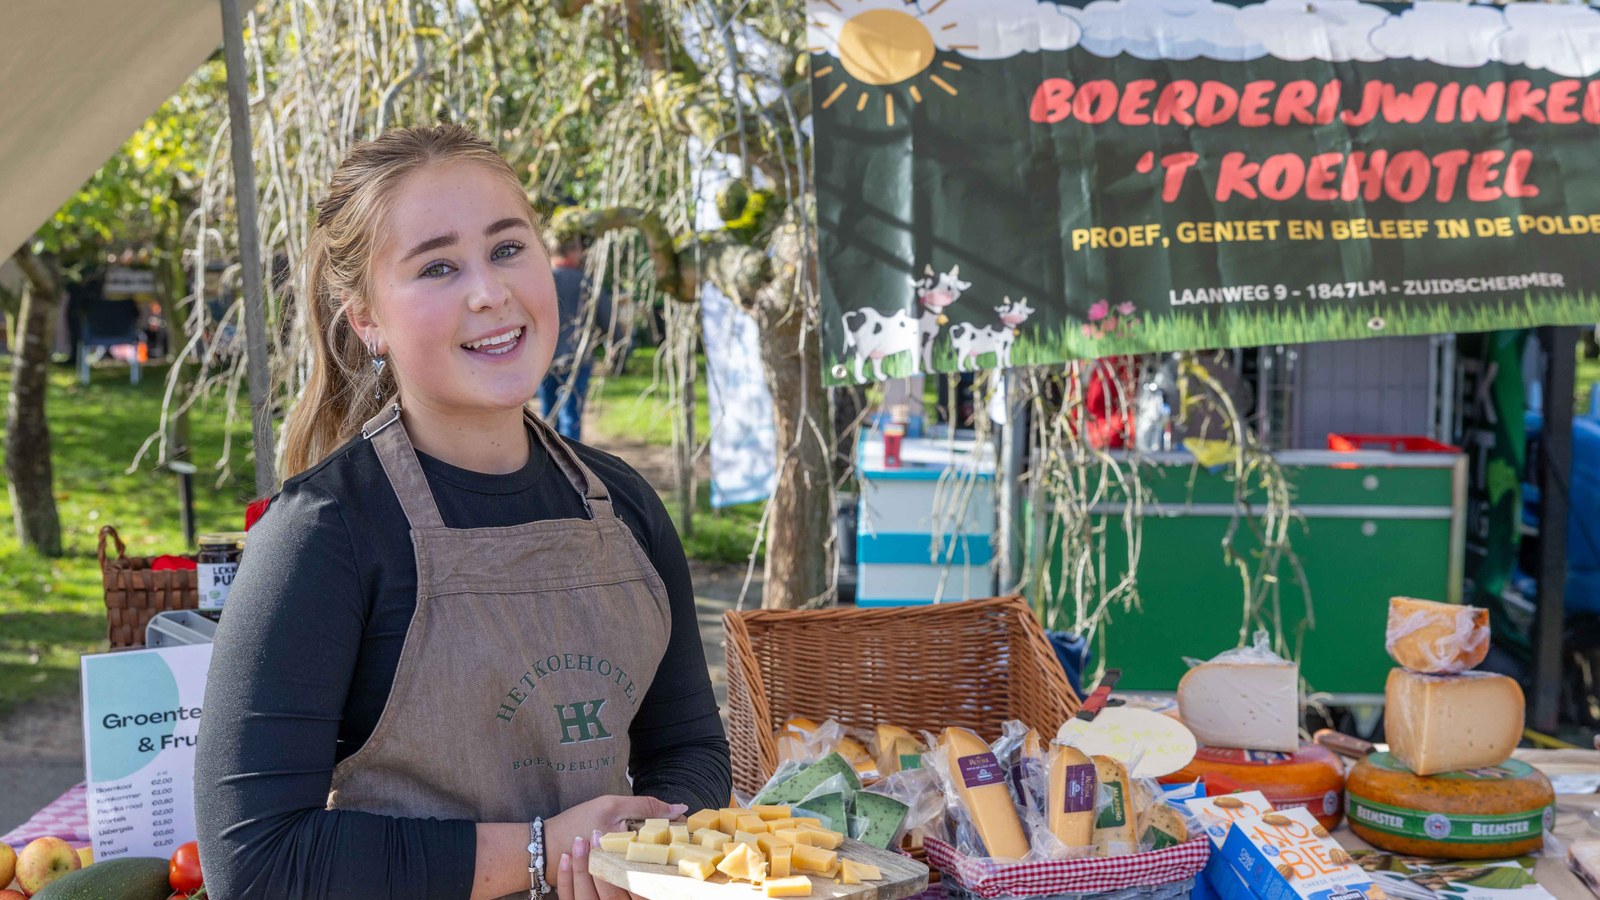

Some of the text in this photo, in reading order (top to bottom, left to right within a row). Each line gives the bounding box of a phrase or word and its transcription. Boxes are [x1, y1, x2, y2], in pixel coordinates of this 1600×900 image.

[1215, 149, 1540, 202] KOEHOTEL
[1072, 224, 1169, 250] PROEF,
[1176, 220, 1281, 244] GENIET
[1288, 220, 1324, 241] EN
[1331, 219, 1430, 240] BELEEF
[1437, 218, 1471, 239] IN
[1474, 217, 1514, 238] DE
[1169, 283, 1271, 306] LAANWEG
[1275, 284, 1287, 301] 9
[1305, 280, 1387, 300] 1847LM
[1403, 272, 1565, 296] ZUIDSCHERMER
[102, 706, 202, 729] Groente
[554, 699, 612, 743] HK
[138, 734, 198, 753] & Fru
[1356, 805, 1404, 828] BEEMSTER
[1472, 822, 1529, 836] BEEMSTER
